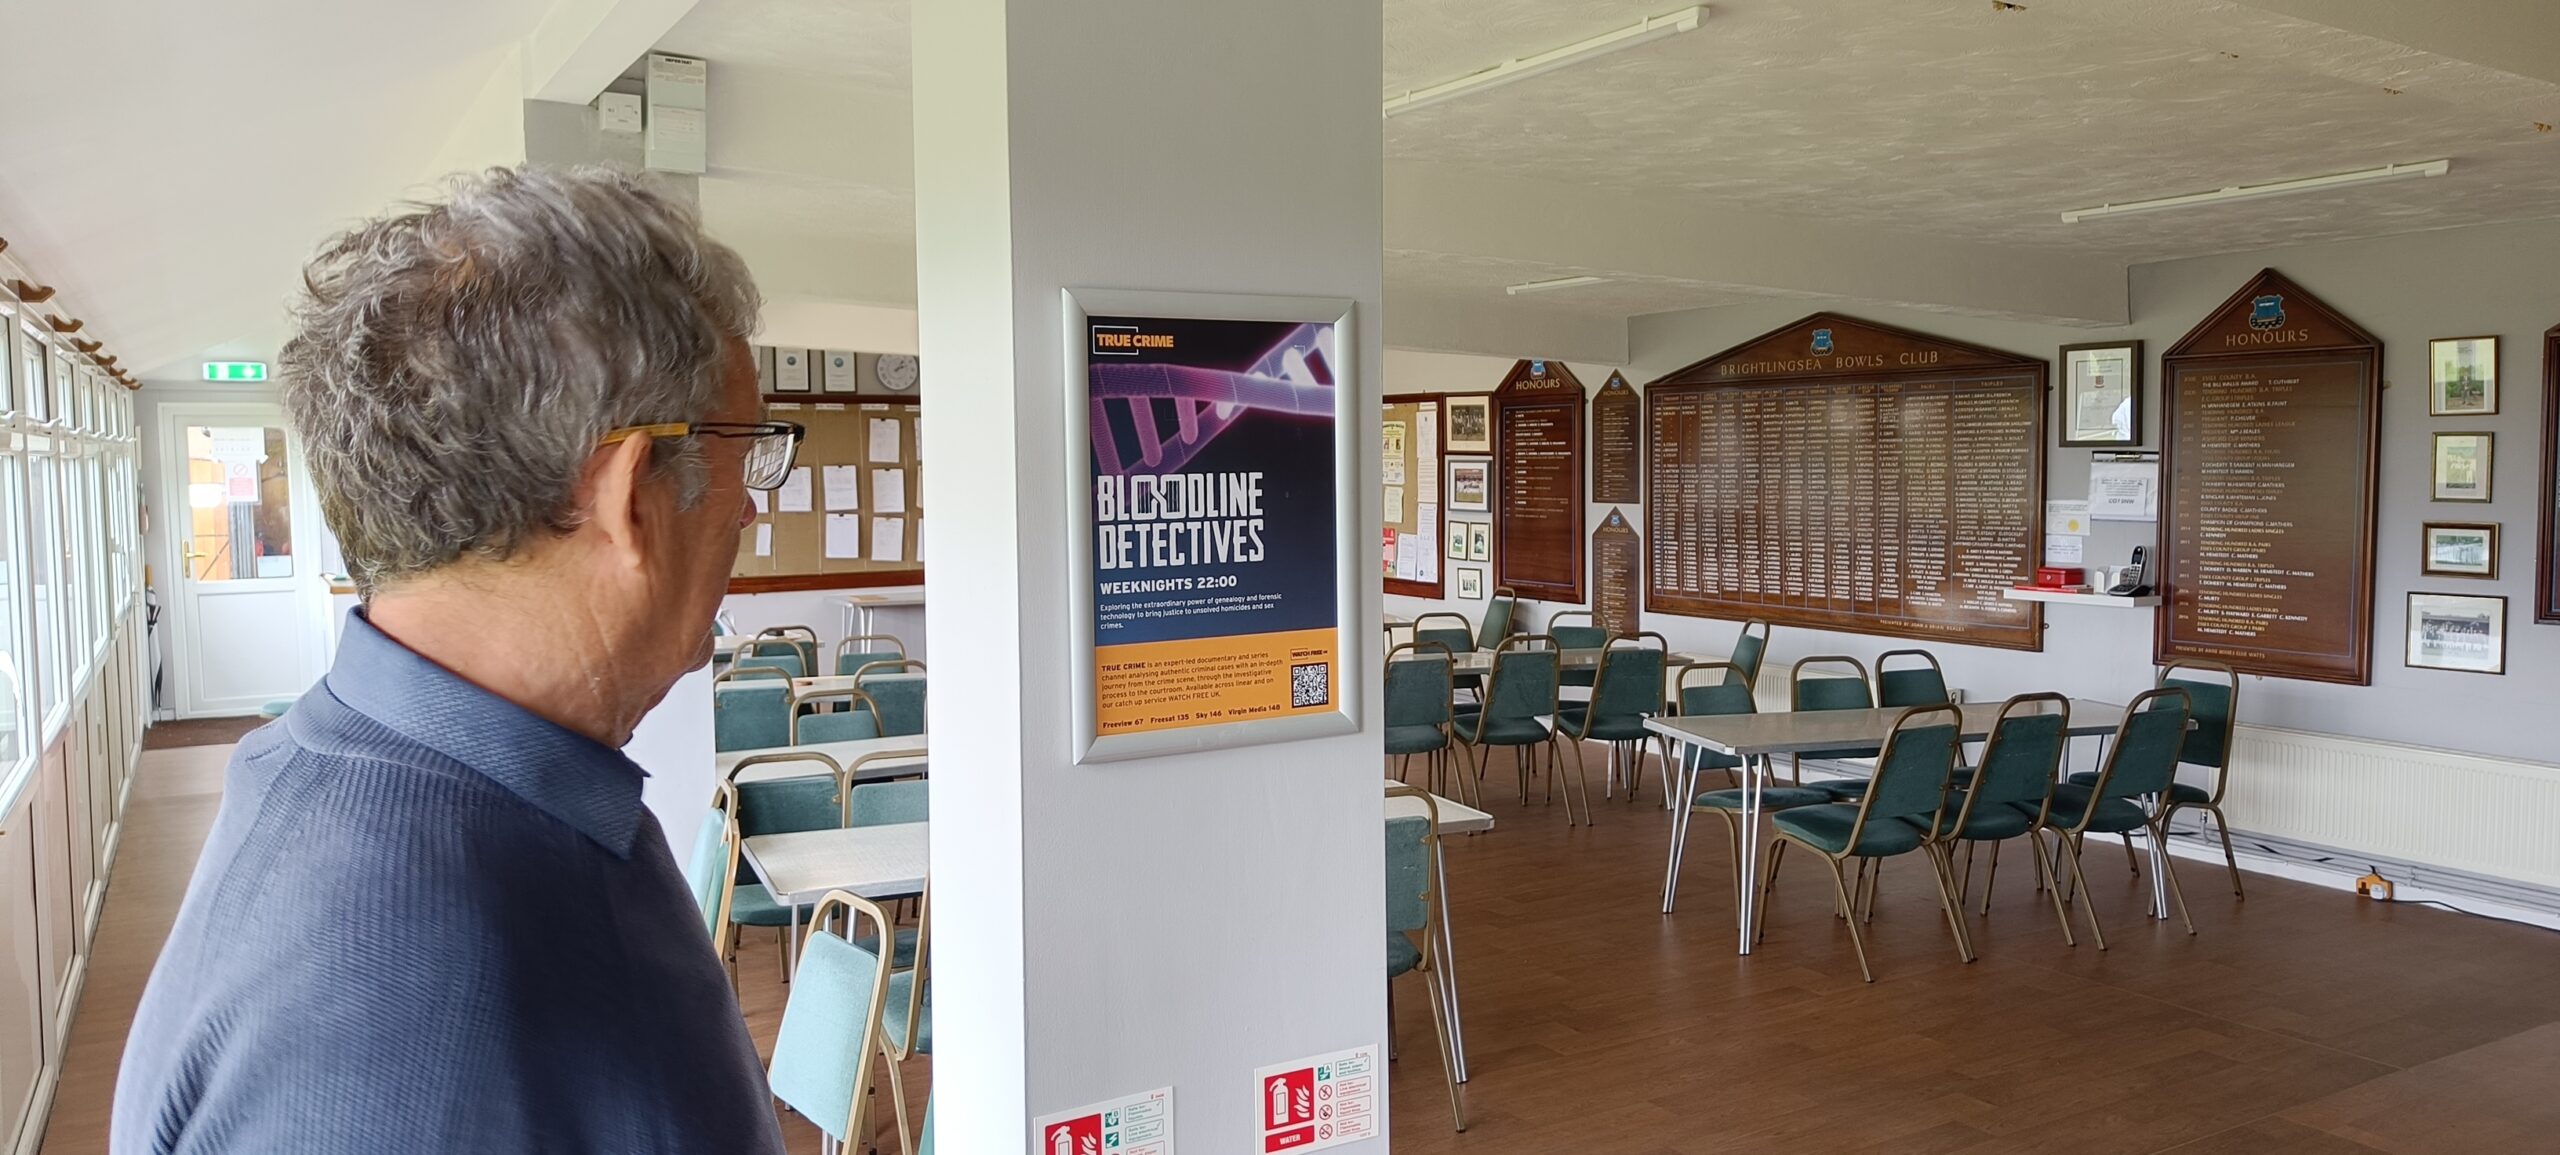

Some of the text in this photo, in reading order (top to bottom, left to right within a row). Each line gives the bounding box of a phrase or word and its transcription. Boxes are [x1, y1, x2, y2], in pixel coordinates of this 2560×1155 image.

[1097, 334, 1174, 347] TRUE CRIME
[2226, 329, 2308, 346] HONOURS
[1721, 351, 1938, 376] BRIGHTLINGSEA BOWLS CLUB
[1516, 378, 1560, 390] HONOURS
[1098, 472, 1263, 522] BLOODLINE
[1099, 519, 1264, 570] DETECTIVES
[1100, 575, 1237, 595] WEEKNIGHTS 22:00
[1100, 603, 1131, 612] Exploring
[1144, 600, 1186, 608] extraordinary
[1215, 596, 1245, 605] genealogy
[1246, 594, 1257, 602] and
[1259, 593, 1282, 601] forensic
[1100, 612, 1135, 621] technology
[1145, 610, 1161, 618] bring
[1163, 609, 1184, 617] justice
[1193, 606, 1220, 614] unsolved
[1221, 604, 1251, 612] homicides
[1100, 622, 1124, 630] crimes.
[1102, 664, 1121, 672] TRUE
[1123, 662, 1146, 670] CRIME
[1163, 658, 1196, 667] expert-led
[1197, 655, 1237, 664] documentary
[1239, 653, 1249, 661] and
[1102, 672, 1127, 681] channel
[1128, 670, 1159, 679] analysing
[1160, 667, 1190, 676] authentic
[1191, 664, 1216, 673] criminal
[1236, 660, 1249, 668] with
[1259, 659, 1284, 668] in-depth
[1102, 682, 1126, 691] journey
[1157, 677, 1175, 685] crime
[1197, 673, 1221, 682] through
[1222, 671, 1233, 679] the
[1234, 669, 1272, 679] investigative
[1102, 692, 1127, 700] process
[1186, 682, 1213, 691] Available
[1214, 681, 1234, 689] across
[1236, 678, 1253, 686] linear
[1254, 677, 1265, 685] and
[1115, 700, 1133, 708] catch
[1144, 696, 1167, 705] service
[1168, 693, 1191, 702] WATCH
[1192, 692, 1208, 700] FREE
[1103, 721, 1133, 729] Freeview
[1150, 715, 1175, 724] Freesat
[1228, 707, 1247, 716] Virgin
[1248, 705, 1267, 713] Media
[1280, 1134, 1301, 1145] WATER
